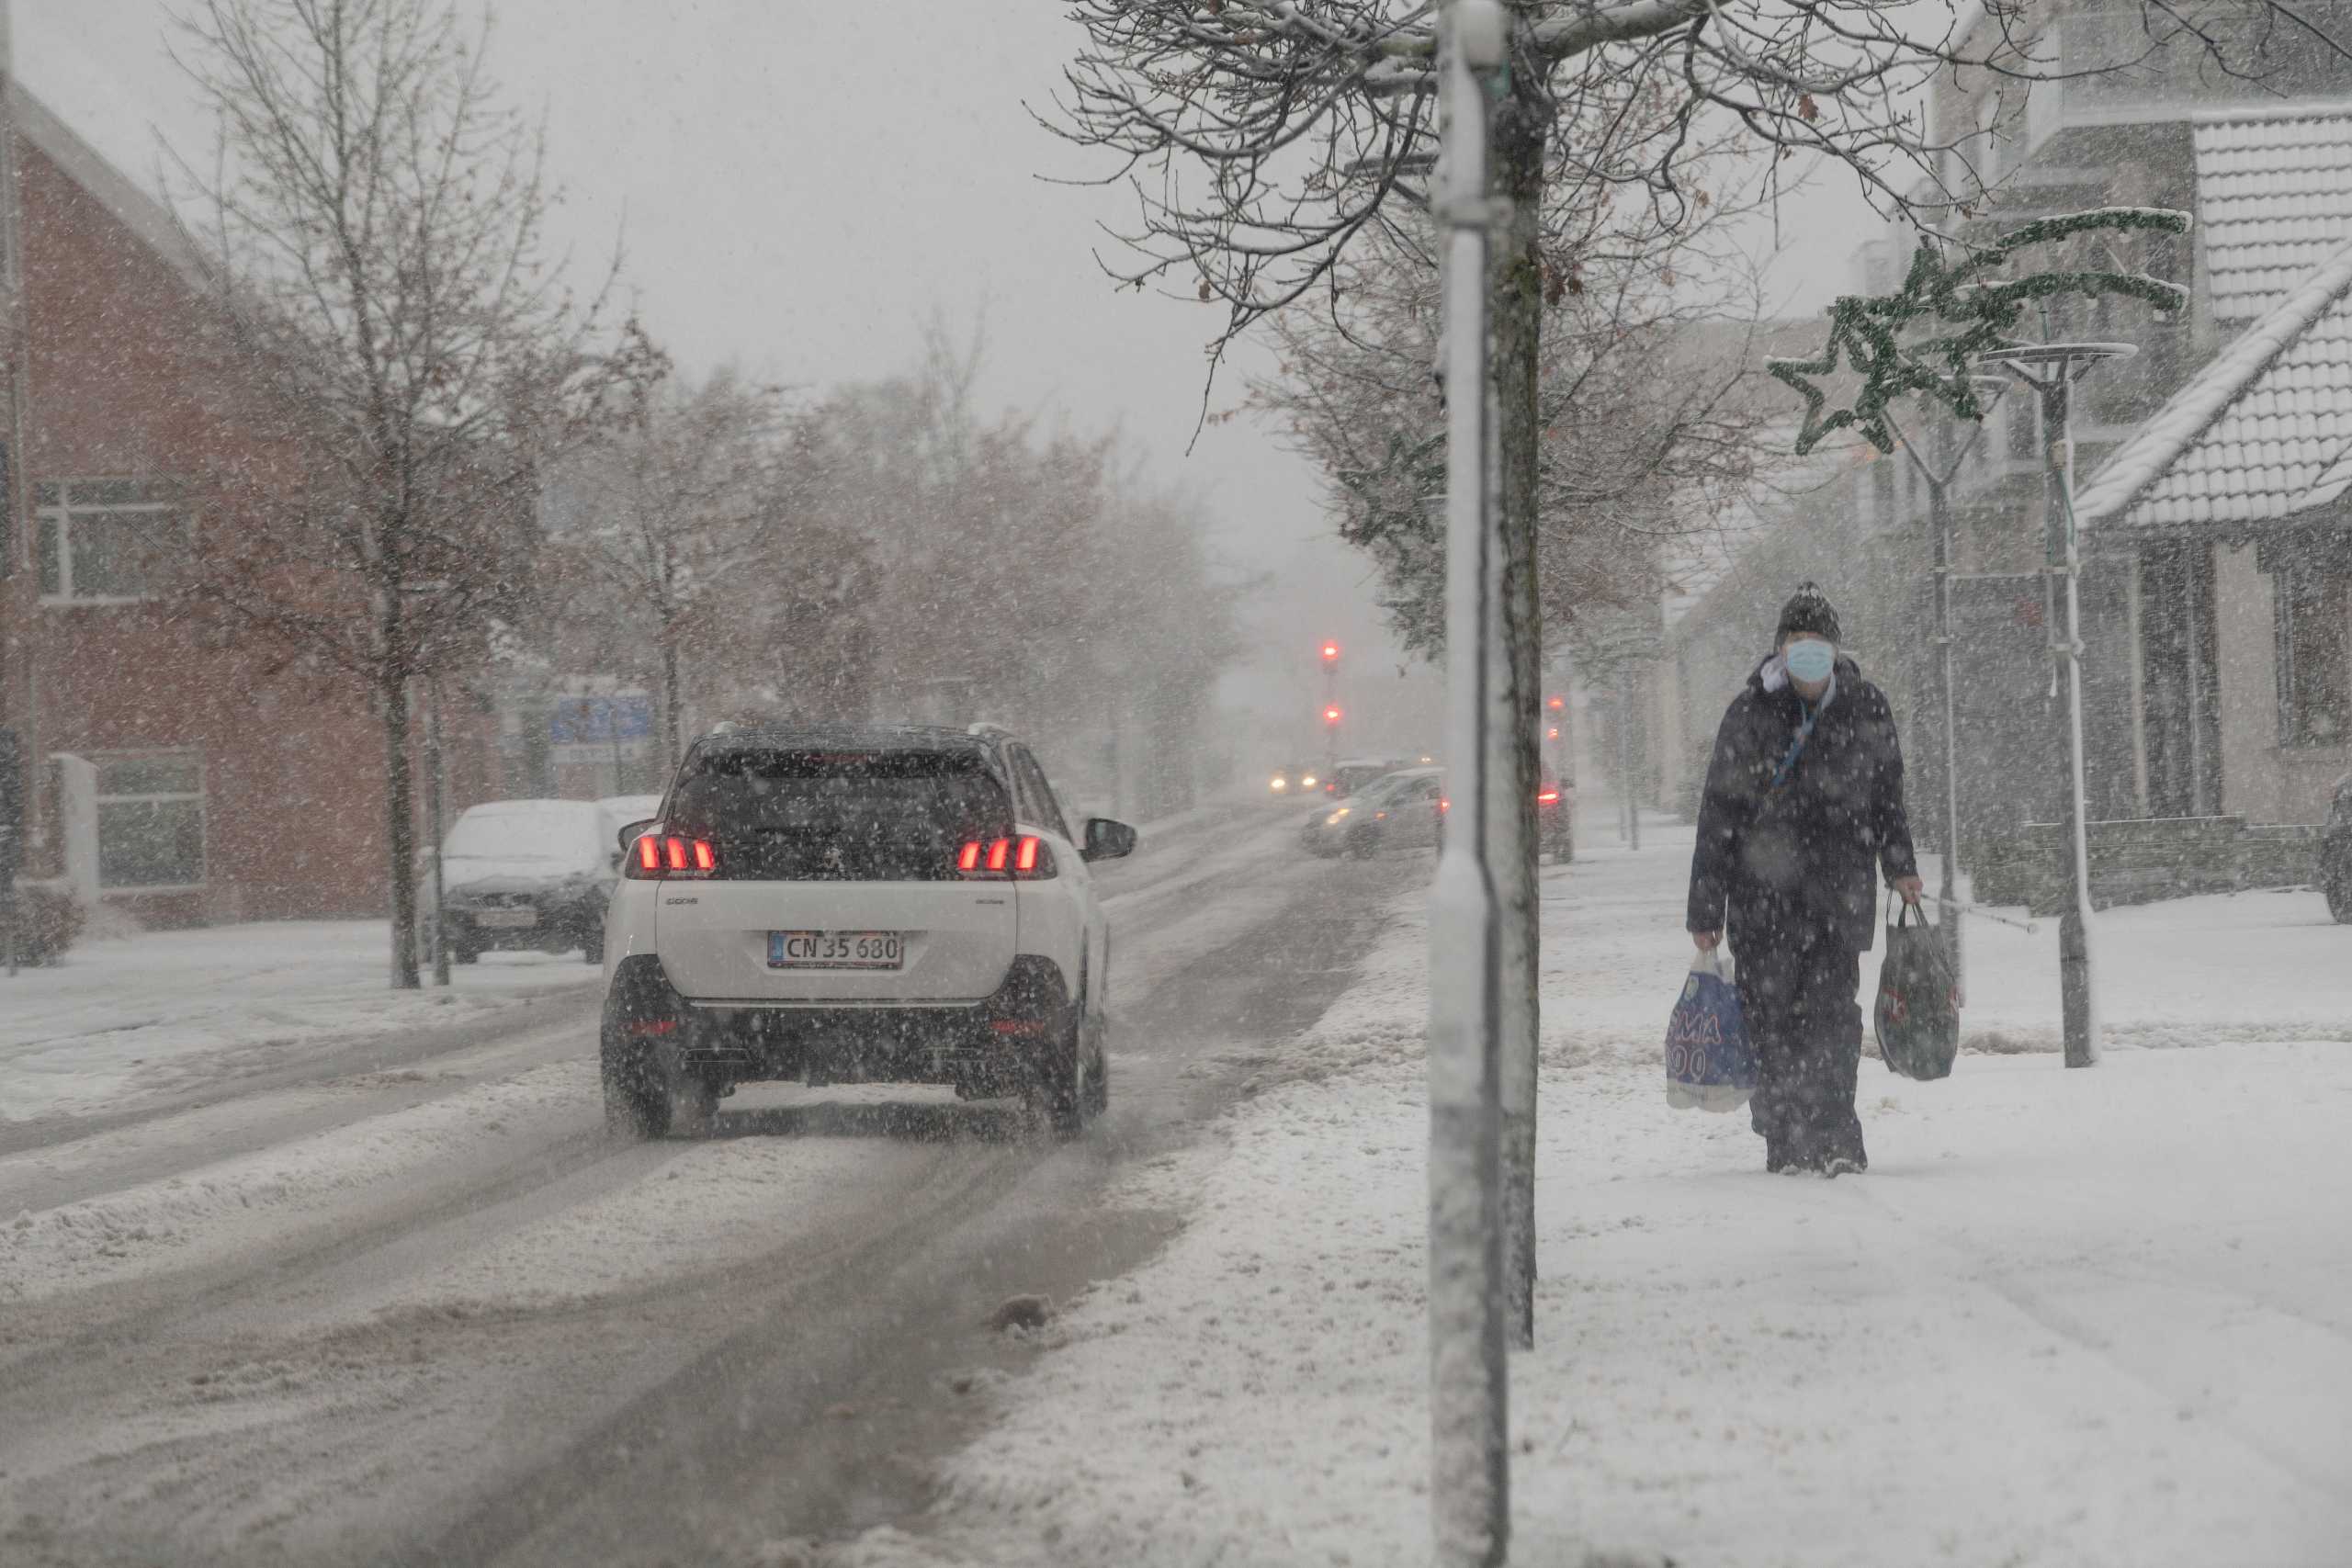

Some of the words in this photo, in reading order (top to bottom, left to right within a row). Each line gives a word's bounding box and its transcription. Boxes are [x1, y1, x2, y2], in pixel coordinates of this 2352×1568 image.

[786, 938, 817, 958] CN
[822, 938, 850, 958] 35
[856, 938, 898, 959] 680
